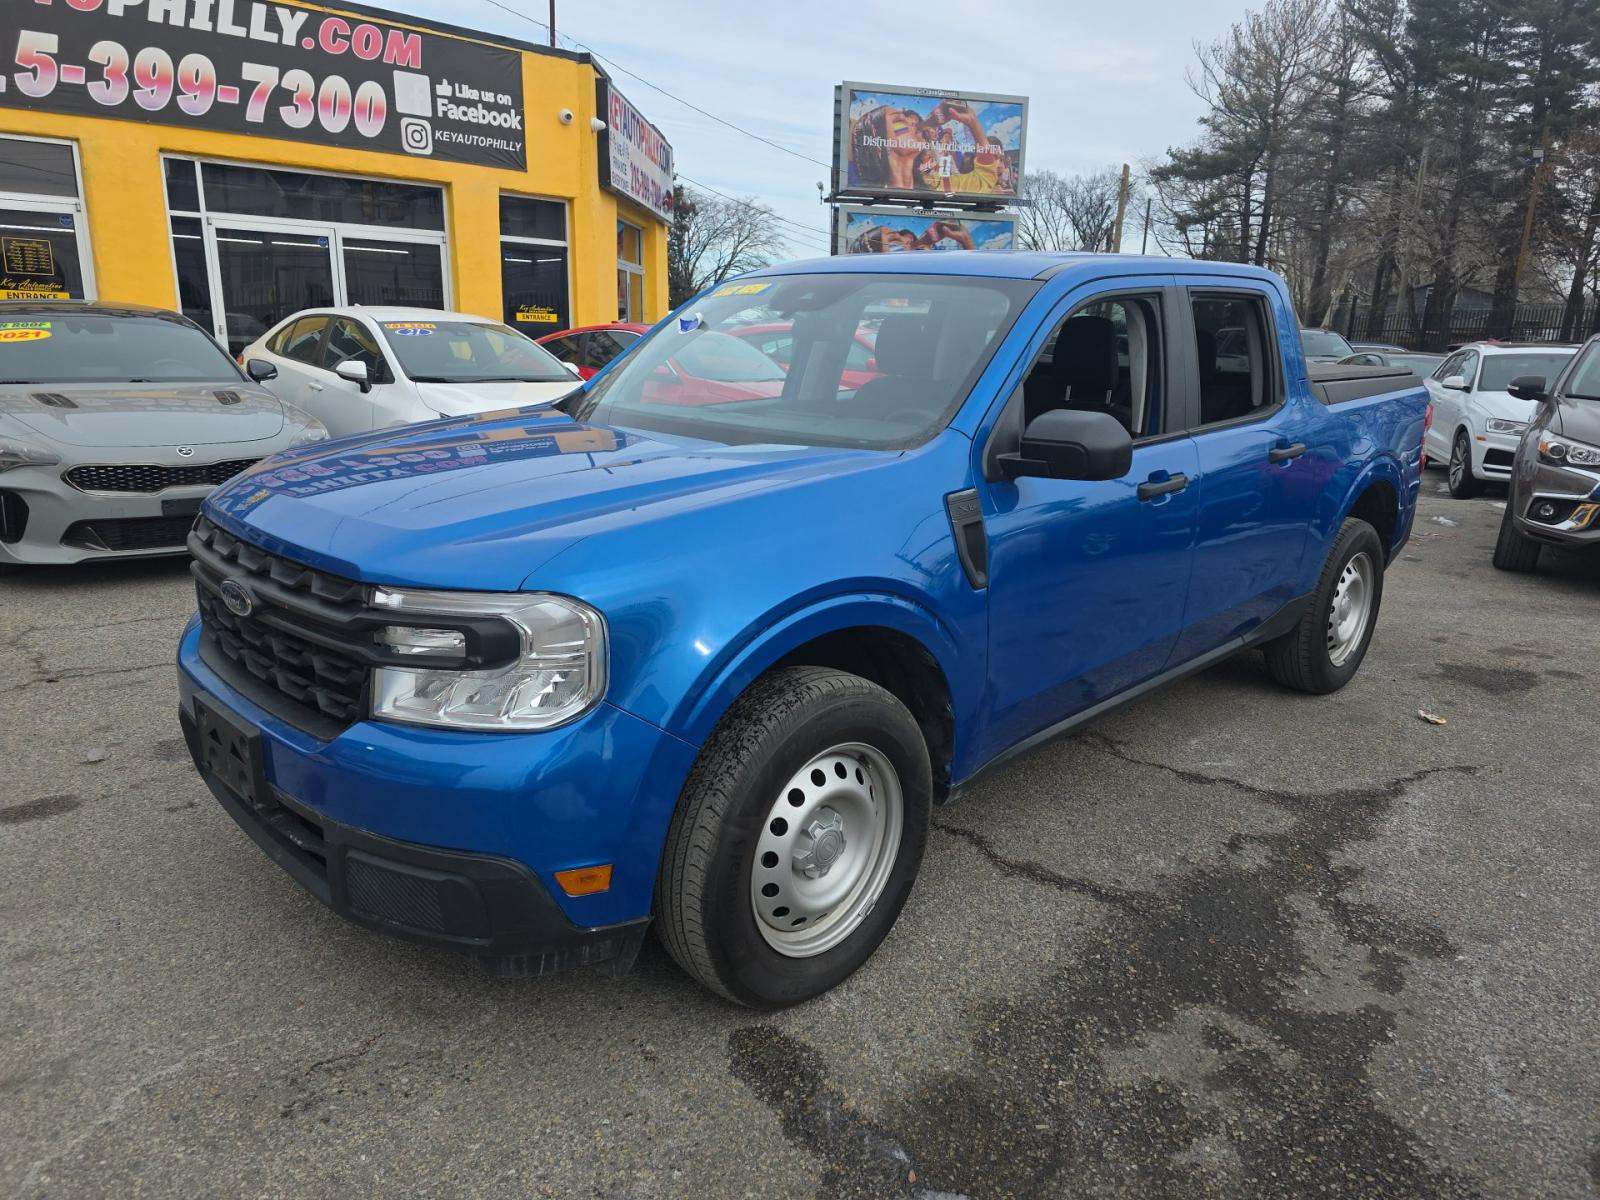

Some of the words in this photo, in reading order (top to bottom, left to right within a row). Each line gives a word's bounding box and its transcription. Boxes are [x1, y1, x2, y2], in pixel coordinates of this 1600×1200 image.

[0, 30, 387, 138] 5-399-7300
[455, 83, 480, 101] Like
[481, 90, 496, 103] us
[497, 93, 512, 106] on
[436, 97, 522, 130] Facebook
[435, 129, 522, 152] KEYAUTOPHILLY
[863, 135, 898, 150] Disfruta
[6, 291, 59, 300] ENTRANCE
[521, 313, 552, 321] ENTRANCE
